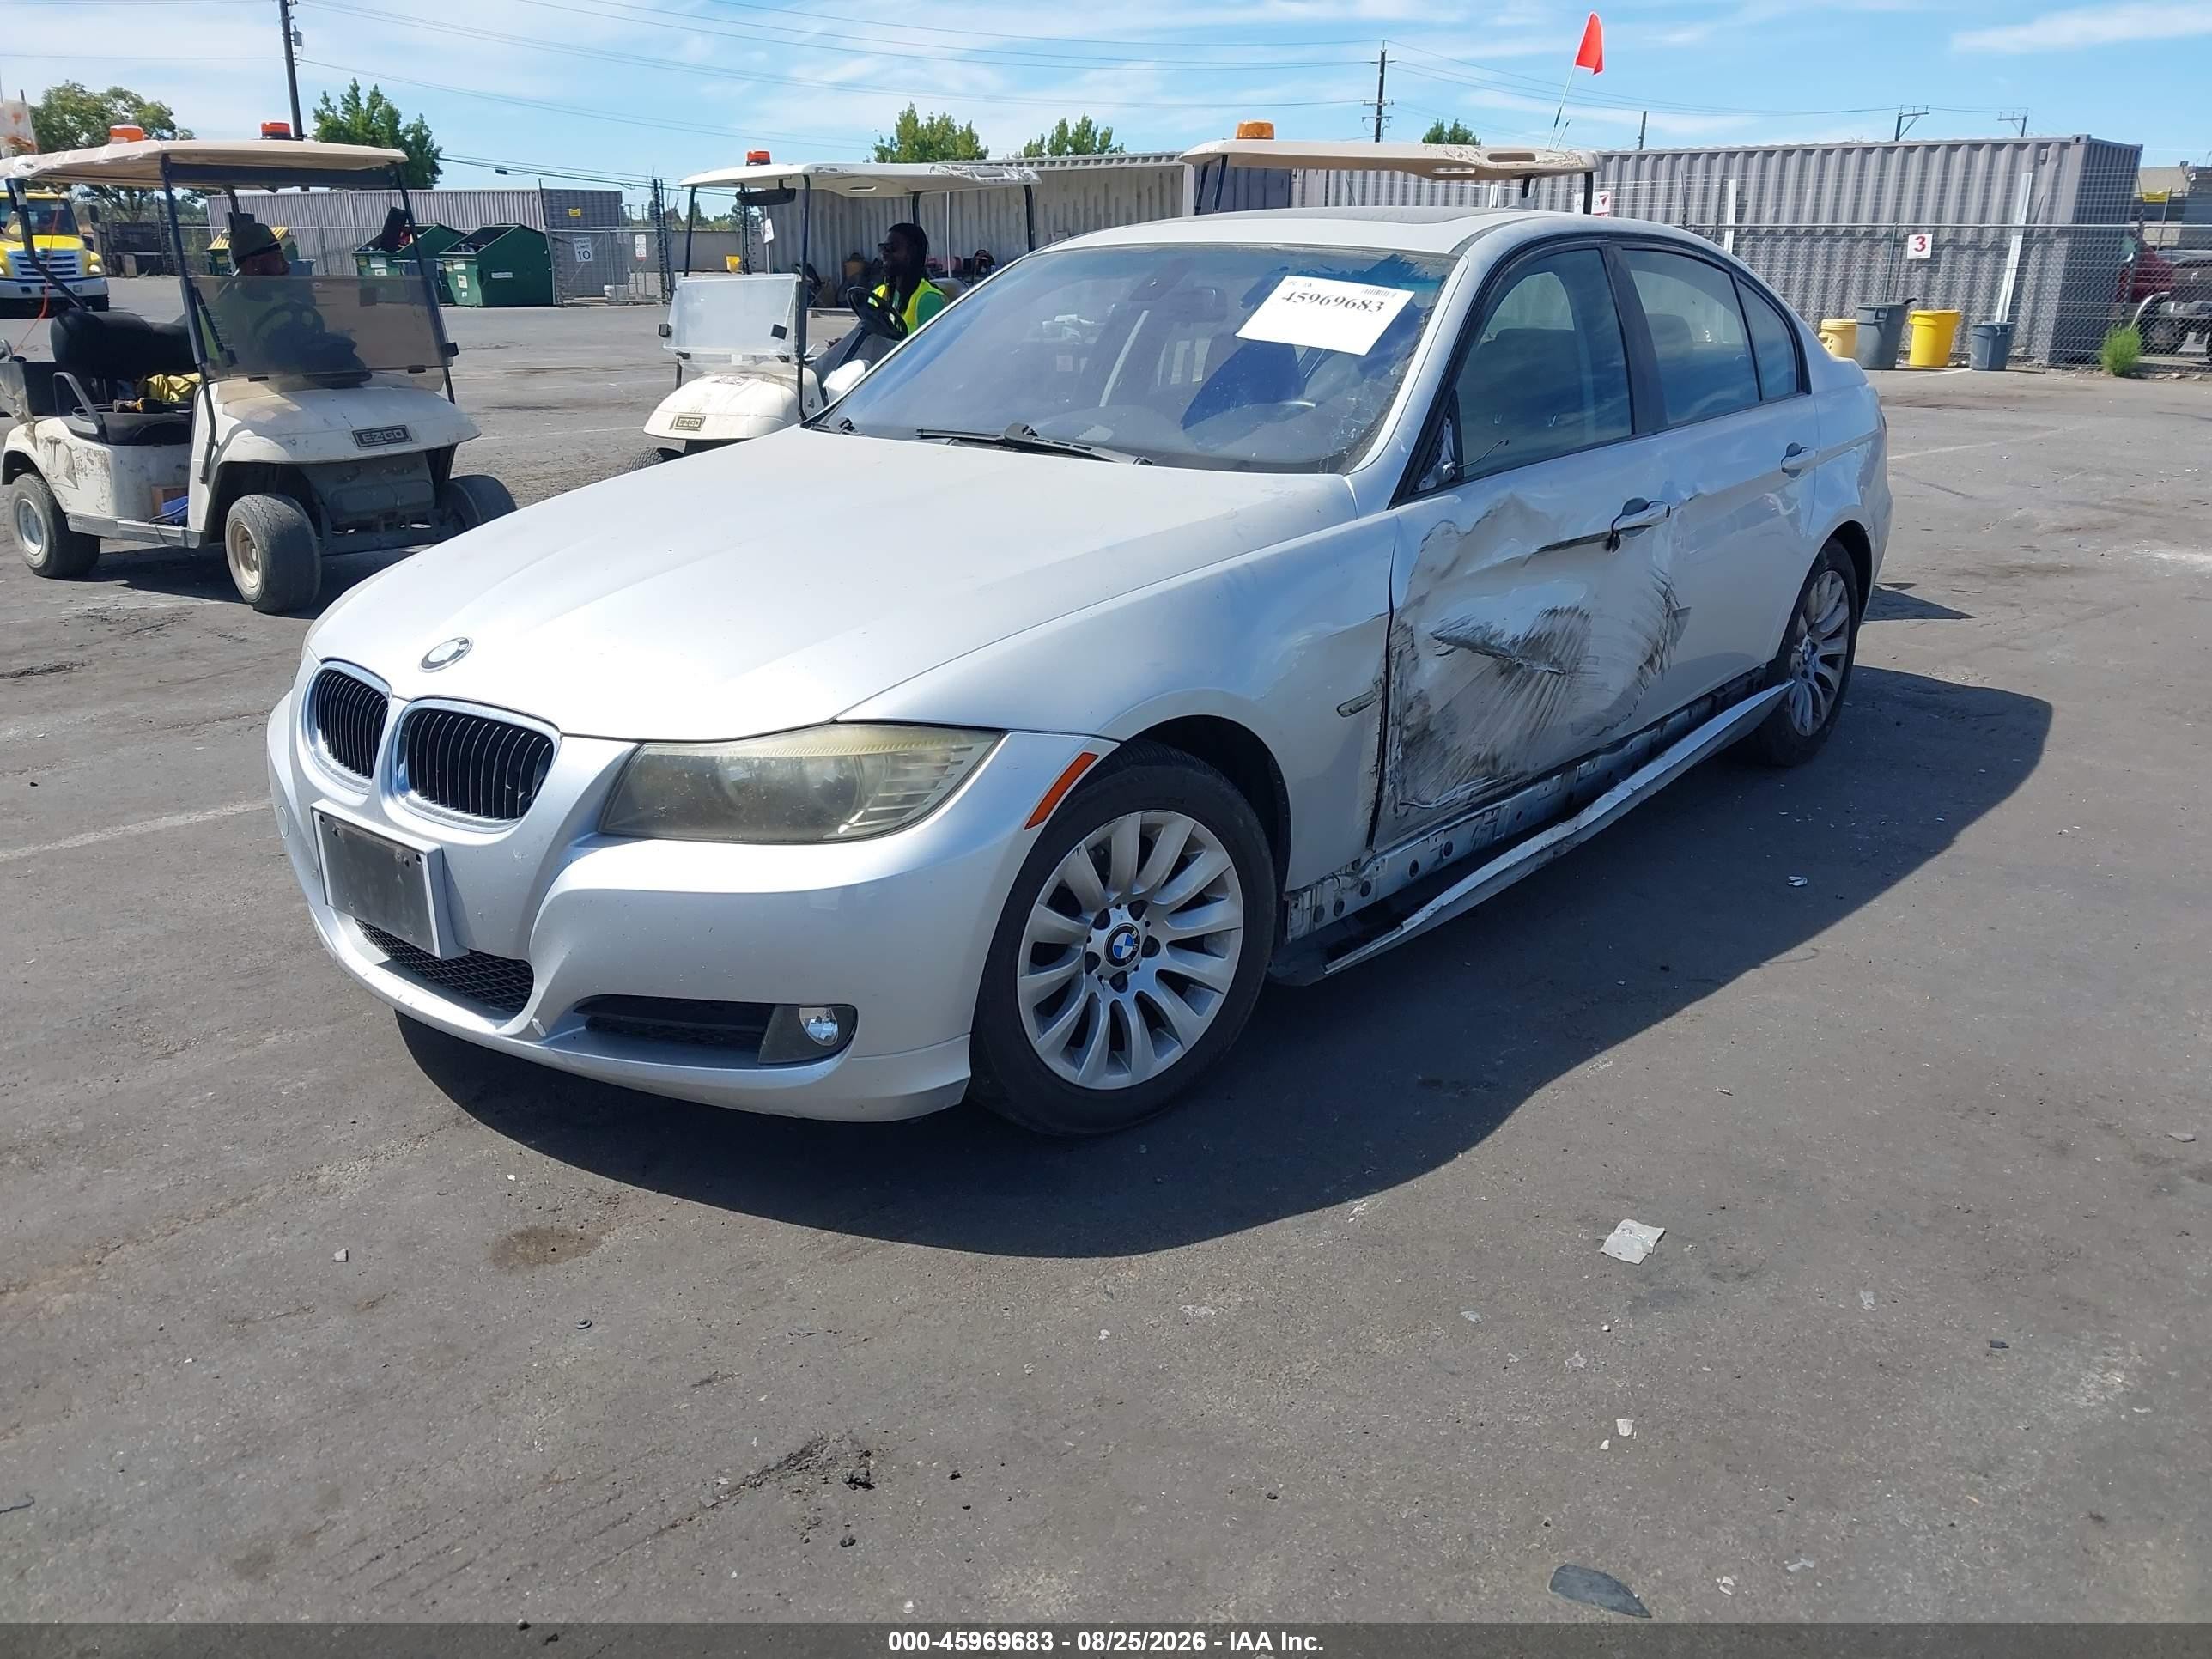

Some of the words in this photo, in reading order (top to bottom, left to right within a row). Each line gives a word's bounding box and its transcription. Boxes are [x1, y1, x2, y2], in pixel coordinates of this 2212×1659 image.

[1914, 235, 1926, 252] 3
[578, 250, 591, 260] 10
[1282, 290, 1385, 313] 45969683
